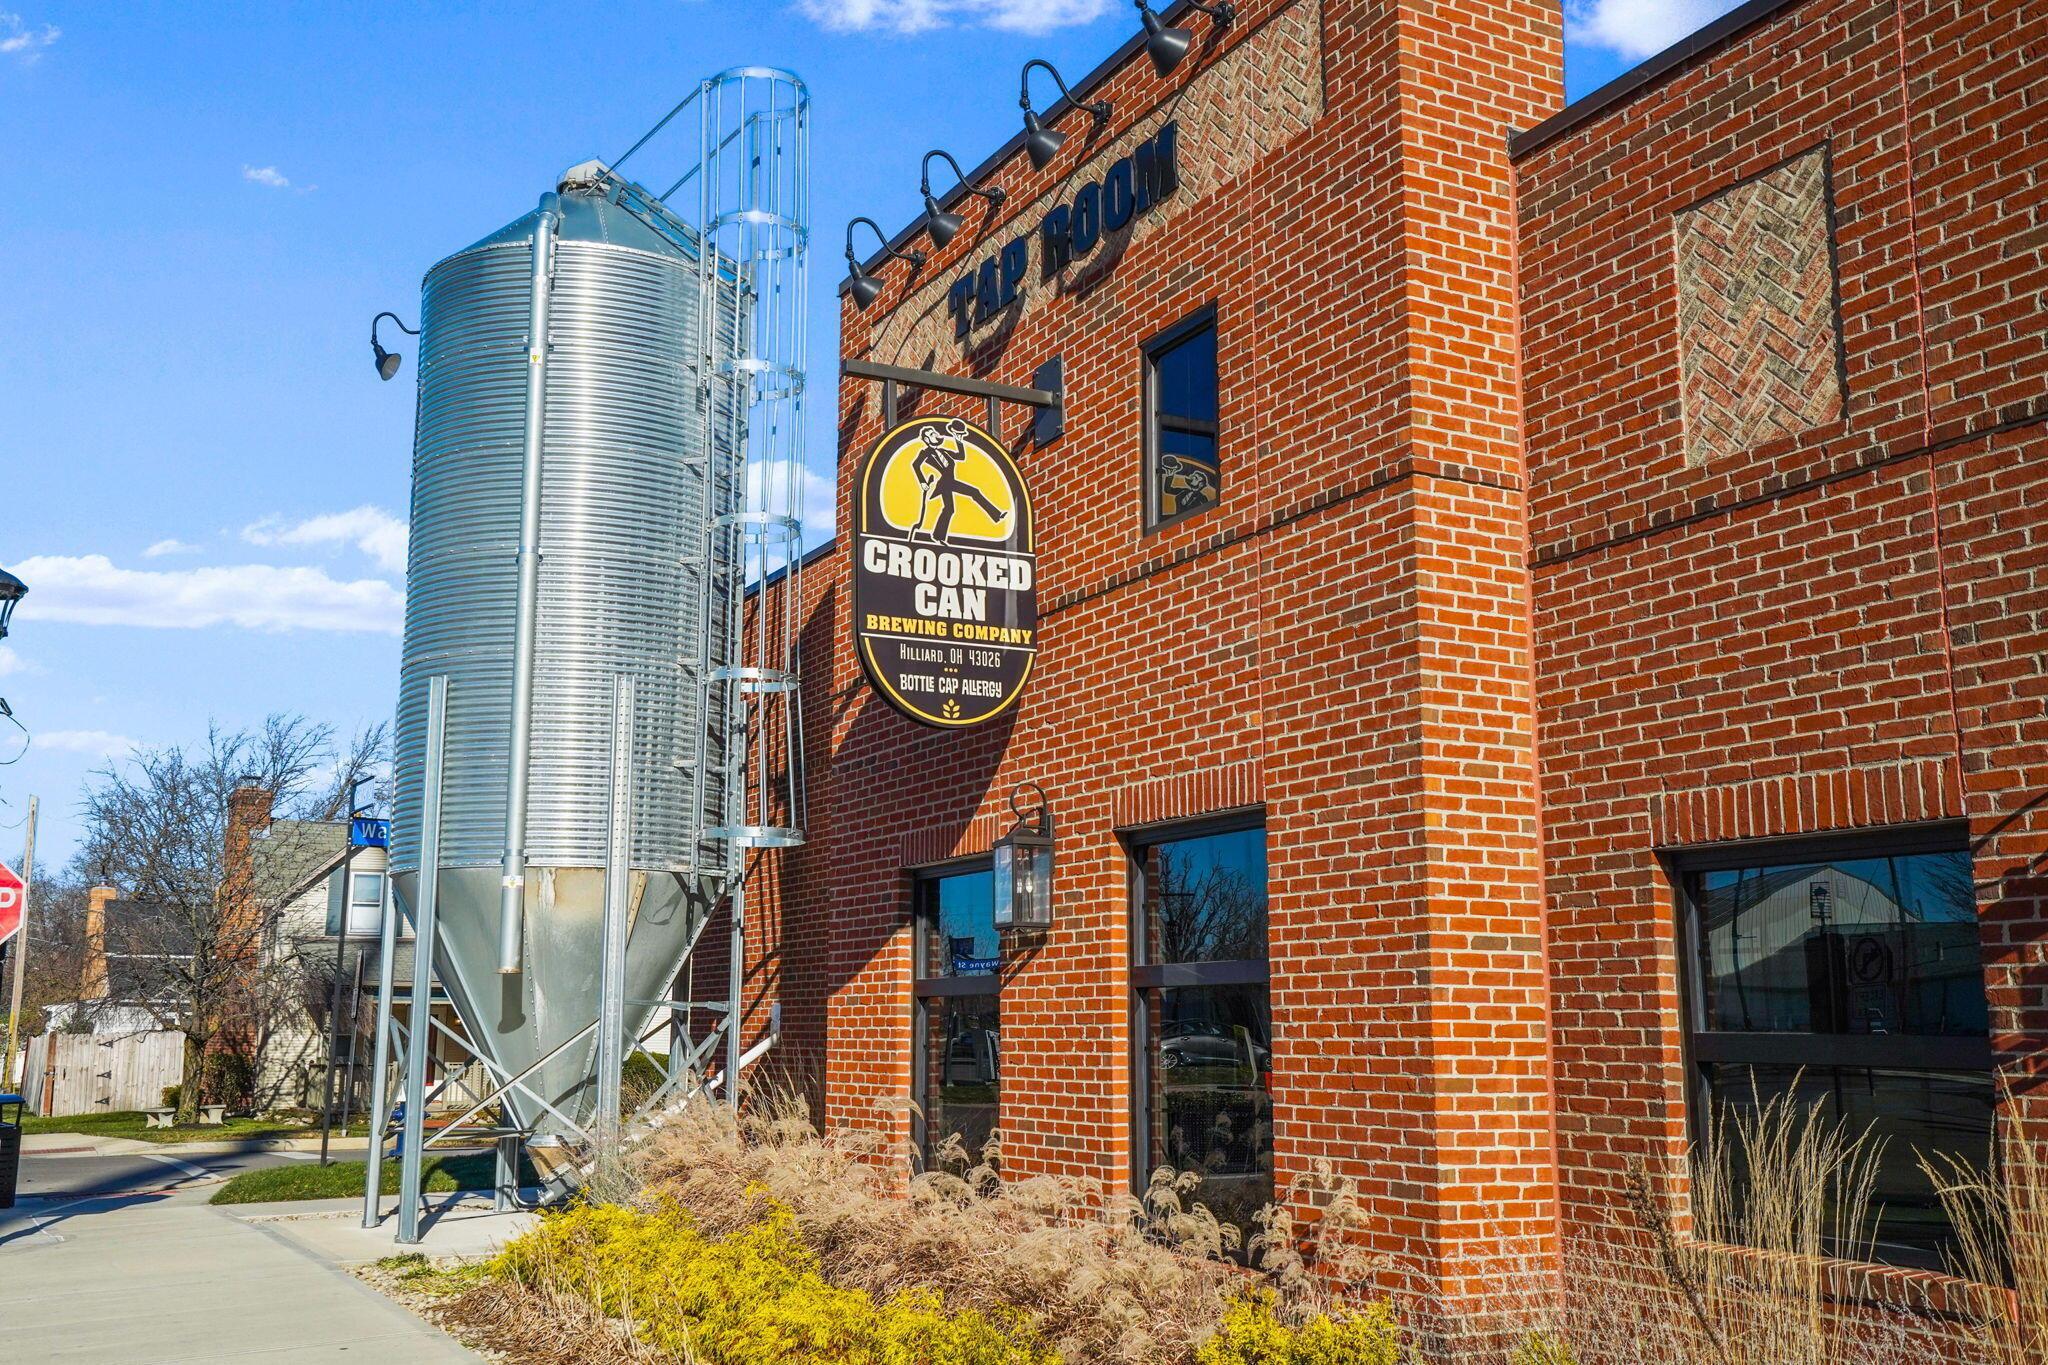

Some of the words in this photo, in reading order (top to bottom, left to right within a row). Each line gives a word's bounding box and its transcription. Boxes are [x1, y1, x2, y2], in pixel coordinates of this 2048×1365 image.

[948, 236, 1028, 338] TAP
[1041, 119, 1180, 284] ROOM
[863, 539, 1032, 591] CROOKED
[914, 582, 986, 622] CAN
[866, 614, 947, 637] BREWING
[952, 622, 1032, 645] COMPANY
[949, 647, 963, 665] OH
[968, 649, 1001, 668] 43026
[938, 676, 959, 695] CAP
[961, 678, 1003, 699] ALLERGY
